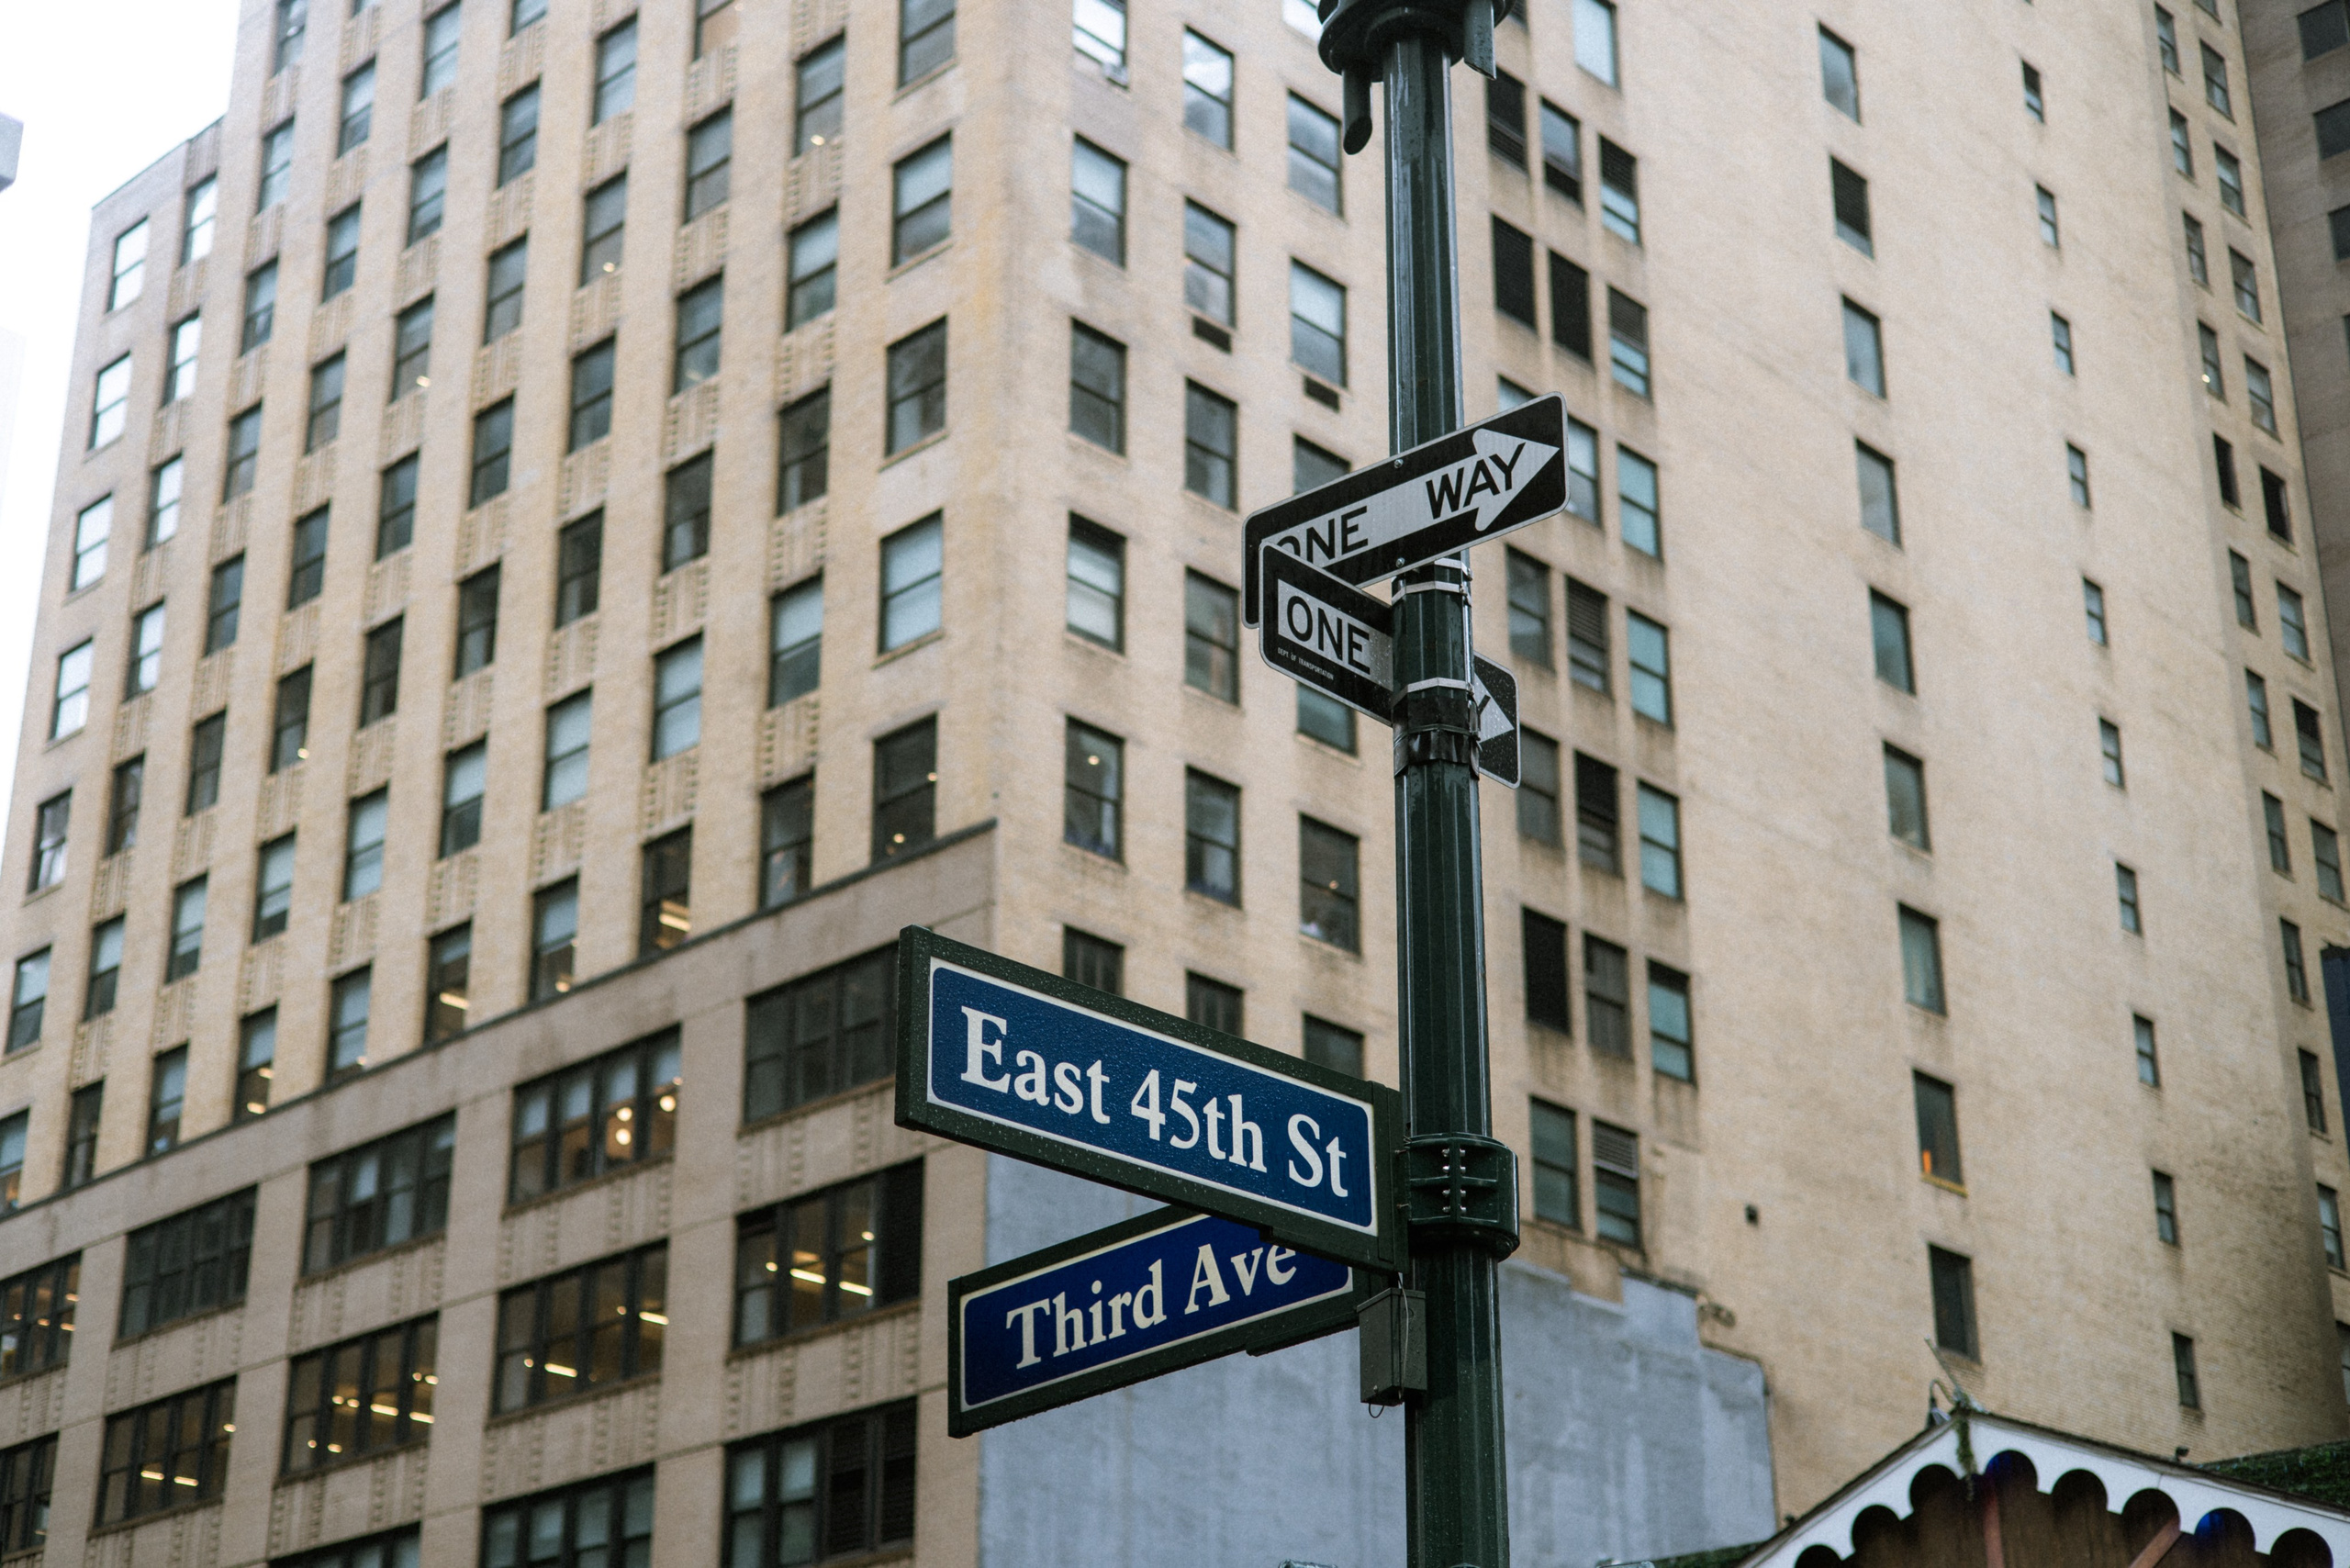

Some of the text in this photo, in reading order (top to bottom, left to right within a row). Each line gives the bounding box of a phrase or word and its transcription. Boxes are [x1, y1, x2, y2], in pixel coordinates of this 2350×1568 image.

[1426, 442, 1526, 519] WAY
[1287, 596, 1371, 675] ONE
[1291, 654, 1297, 662] OF
[1298, 656, 1334, 680] TRANSPORTATION
[961, 1006, 1348, 1198] East 45th St
[1006, 1243, 1297, 1369] Third Ave
